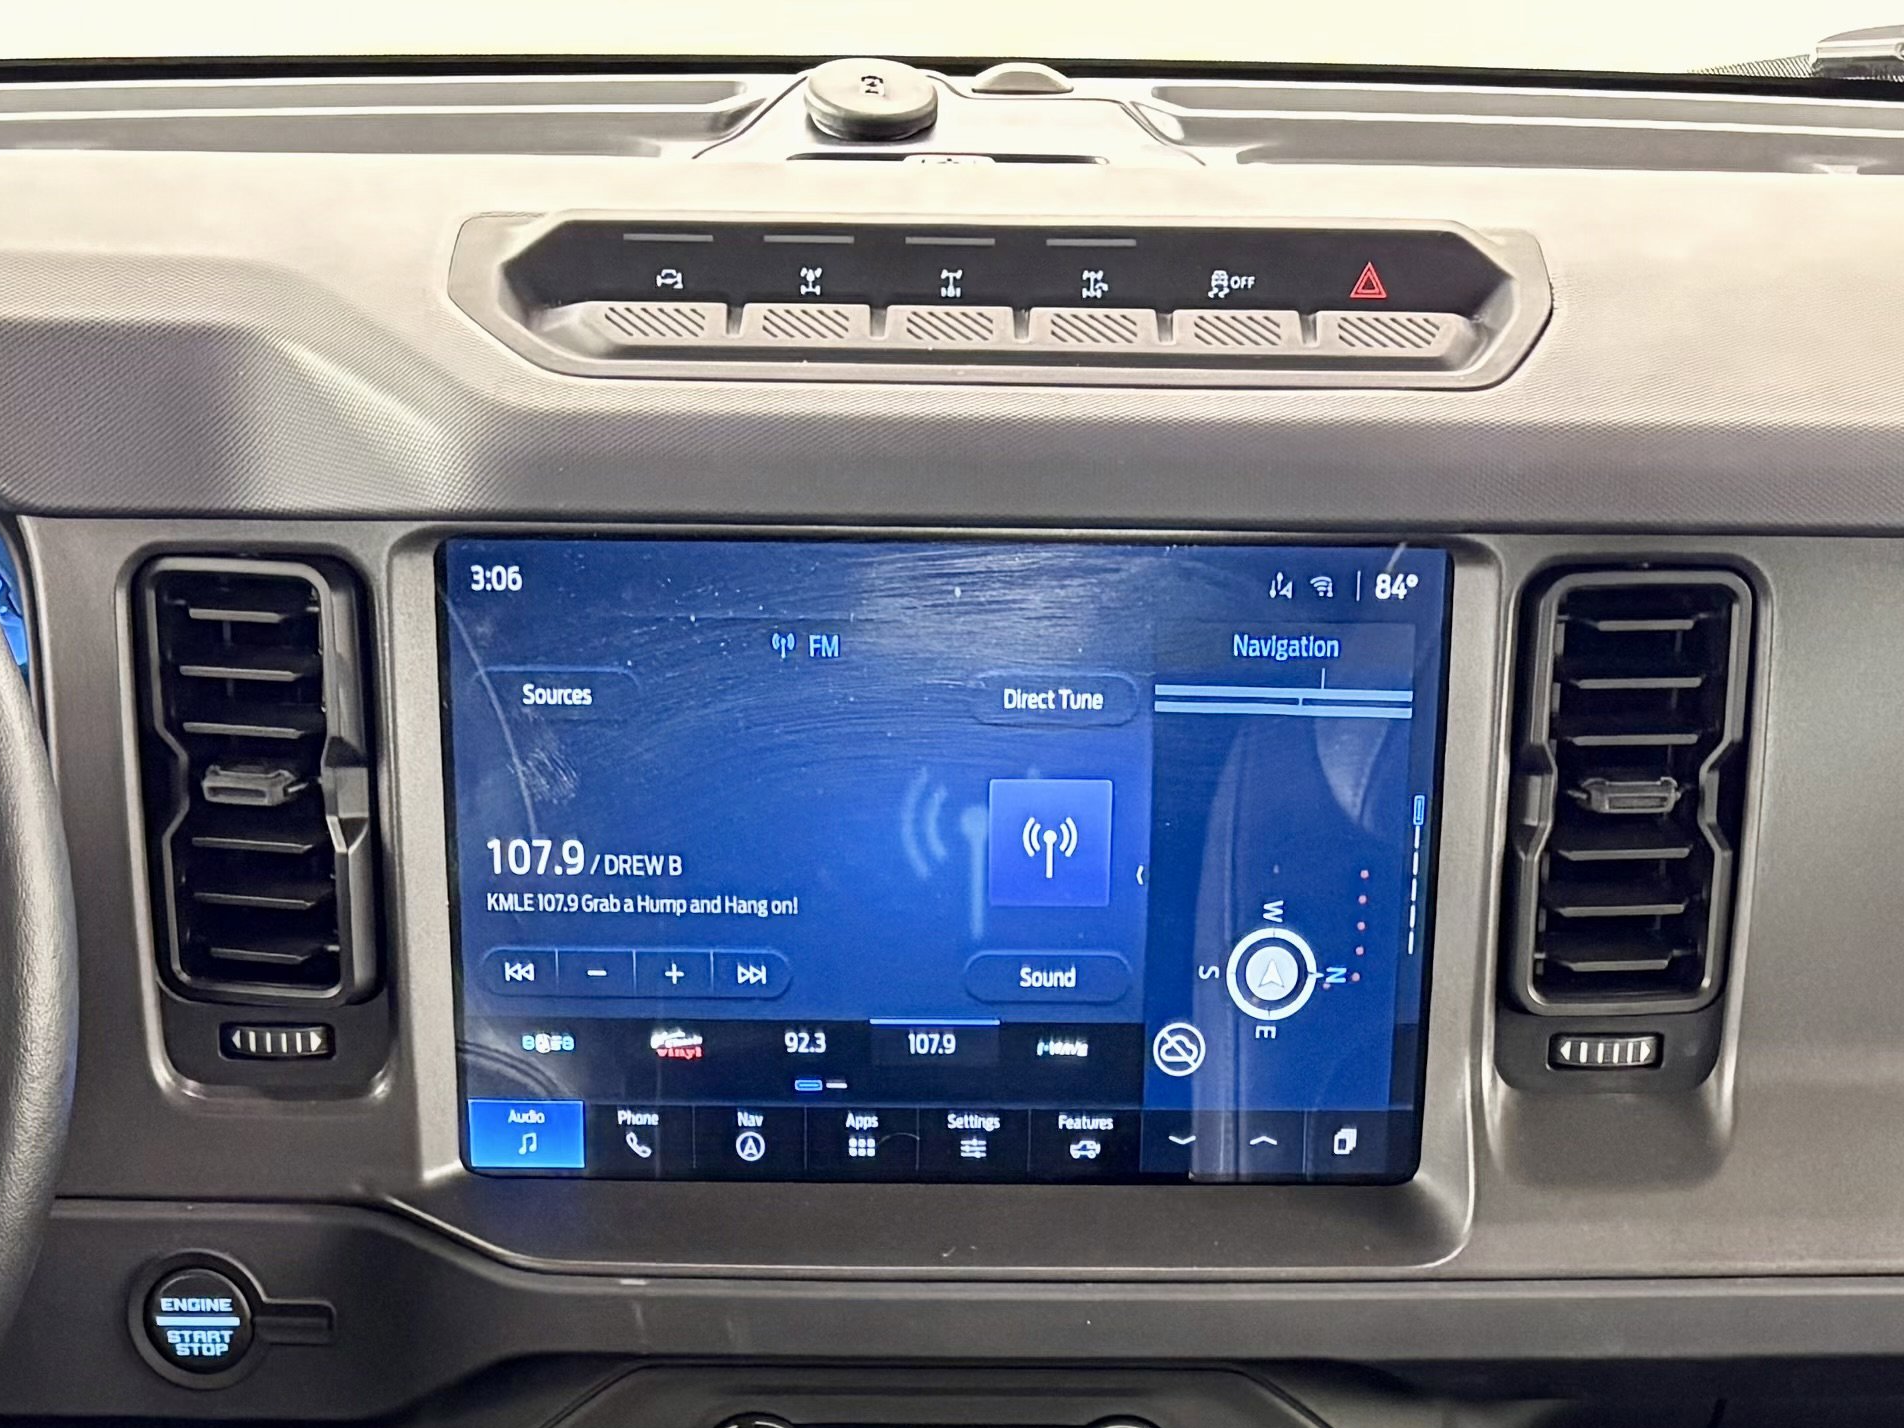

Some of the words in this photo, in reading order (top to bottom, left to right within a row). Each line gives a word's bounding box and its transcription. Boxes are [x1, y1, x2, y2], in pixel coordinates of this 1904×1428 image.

[1229, 275, 1256, 289] OFF
[469, 564, 524, 592] 3:06
[1374, 572, 1420, 600] 84°
[808, 635, 841, 658] FM
[1232, 634, 1340, 662] Navigation
[521, 683, 593, 706] Sources
[1003, 687, 1057, 711] Direct
[1059, 689, 1104, 711] Tune
[485, 838, 586, 876] 107.9
[604, 855, 666, 877] DREW
[669, 855, 683, 877] B
[486, 892, 536, 913] KMLE
[537, 892, 580, 914] 107.9
[581, 893, 622, 914] Grab
[623, 898, 635, 914] a
[636, 894, 687, 917] Hump
[689, 895, 723, 915] and
[724, 895, 769, 918] Hang
[770, 896, 799, 915] on!
[1262, 899, 1285, 923] W
[1019, 967, 1077, 989] Sound
[1198, 965, 1220, 980] S
[1325, 966, 1348, 985] N
[1254, 1024, 1277, 1040] E
[784, 1031, 827, 1054] 92.3
[907, 1033, 957, 1056] 107.9
[507, 1108, 546, 1125] Audio
[617, 1109, 659, 1126] Phone
[737, 1111, 764, 1128] Nav
[845, 1111, 880, 1131] Apps
[947, 1113, 1001, 1132] Settings
[1057, 1113, 1115, 1131] Features
[159, 1297, 234, 1312] ENGINE
[166, 1329, 234, 1344] START
[175, 1342, 230, 1357] STOP
